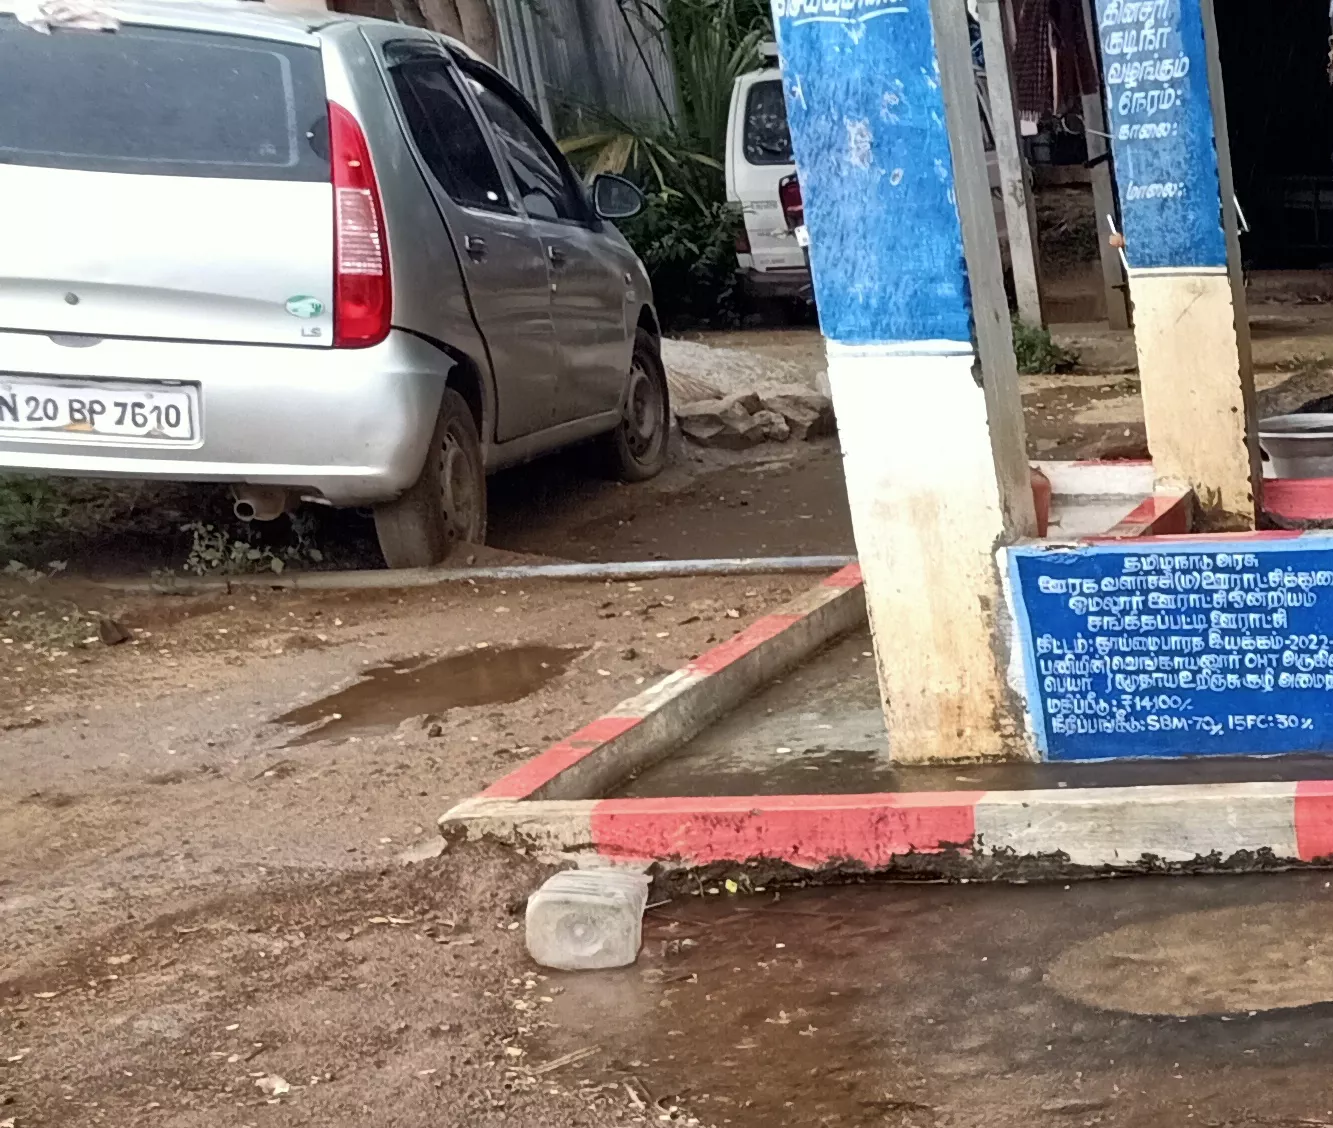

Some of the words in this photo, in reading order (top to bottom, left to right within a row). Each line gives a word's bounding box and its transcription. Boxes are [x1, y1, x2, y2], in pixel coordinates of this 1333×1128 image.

[1105, 19, 1171, 60] குடிநீர்
[1108, 51, 1189, 88] வழங்கும்
[25, 395, 59, 421] 20
[69, 399, 106, 427] BP
[114, 401, 181, 428] 7610
[1216, 553, 1259, 570] அரசு
[1244, 653, 1279, 669] OHT
